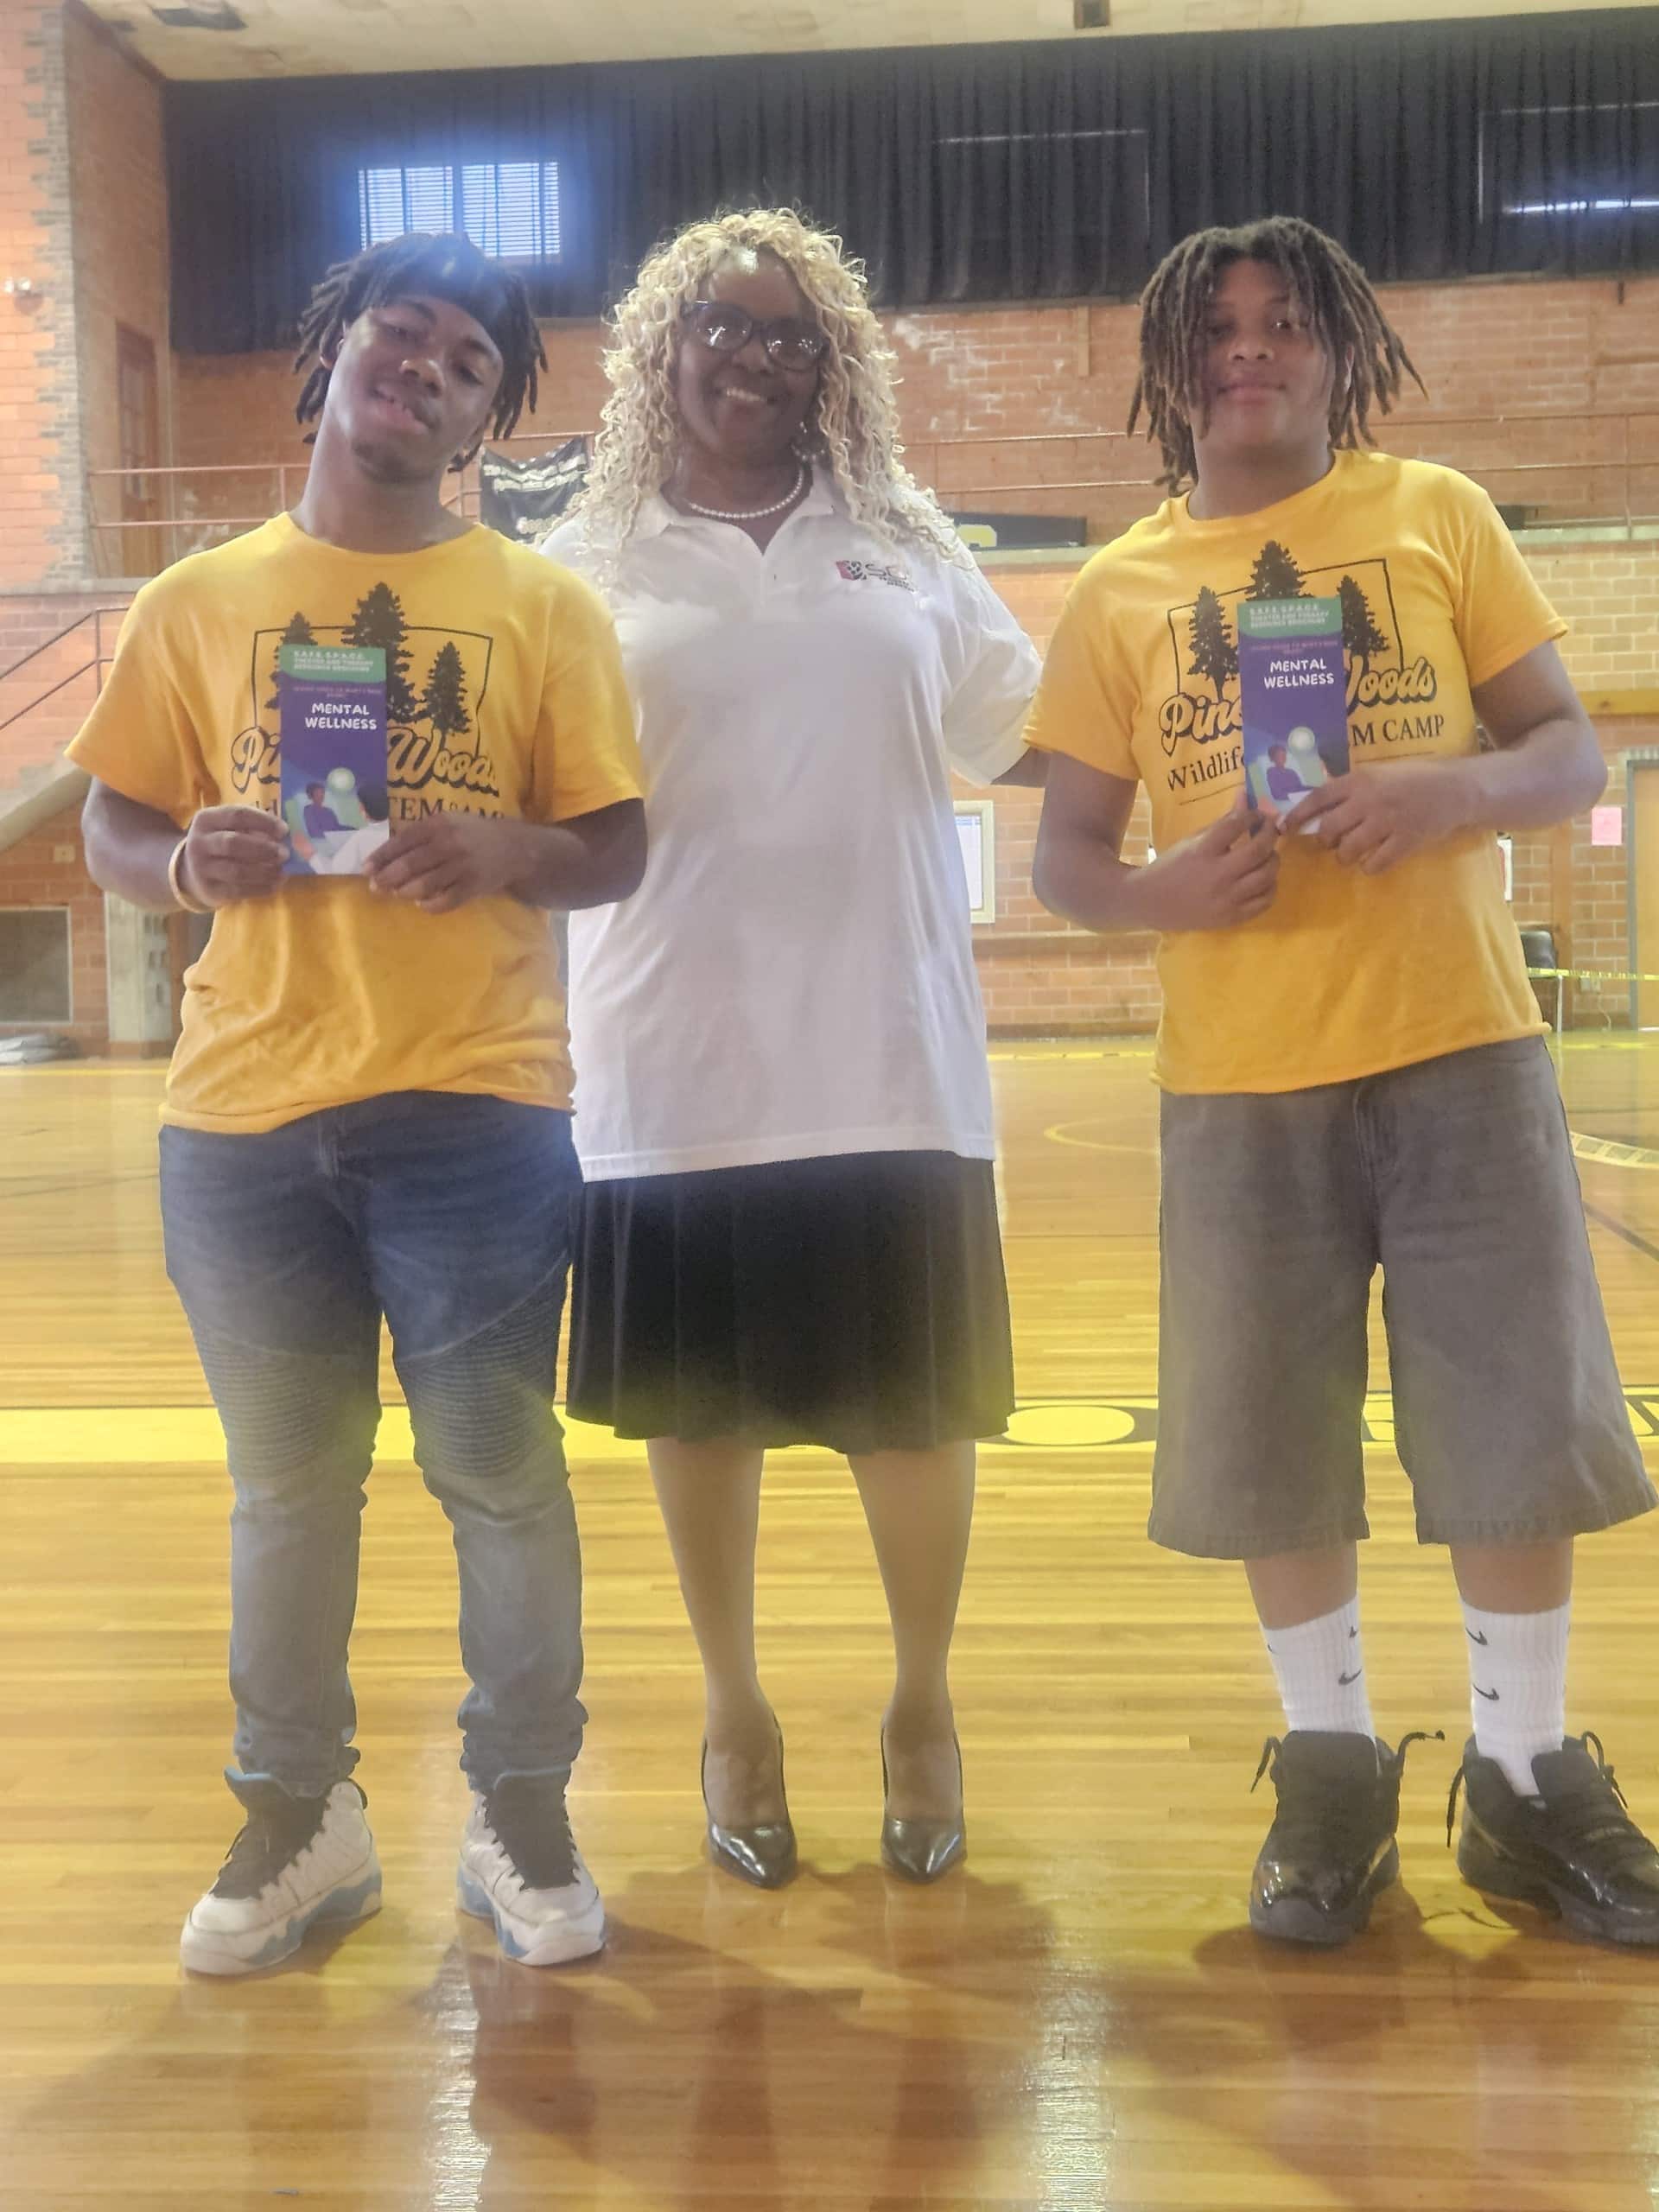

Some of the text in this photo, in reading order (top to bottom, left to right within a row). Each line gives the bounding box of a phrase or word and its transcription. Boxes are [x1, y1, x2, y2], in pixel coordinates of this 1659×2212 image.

[1270, 658, 1326, 673] MENTAL
[1264, 673, 1334, 690] WELLNESS
[1345, 655, 1438, 719] oods
[311, 702, 370, 715] MENTAL
[305, 716, 377, 730] WELLNESS
[1167, 747, 1244, 791] Wildlif
[1382, 714, 1445, 742] CAMP
